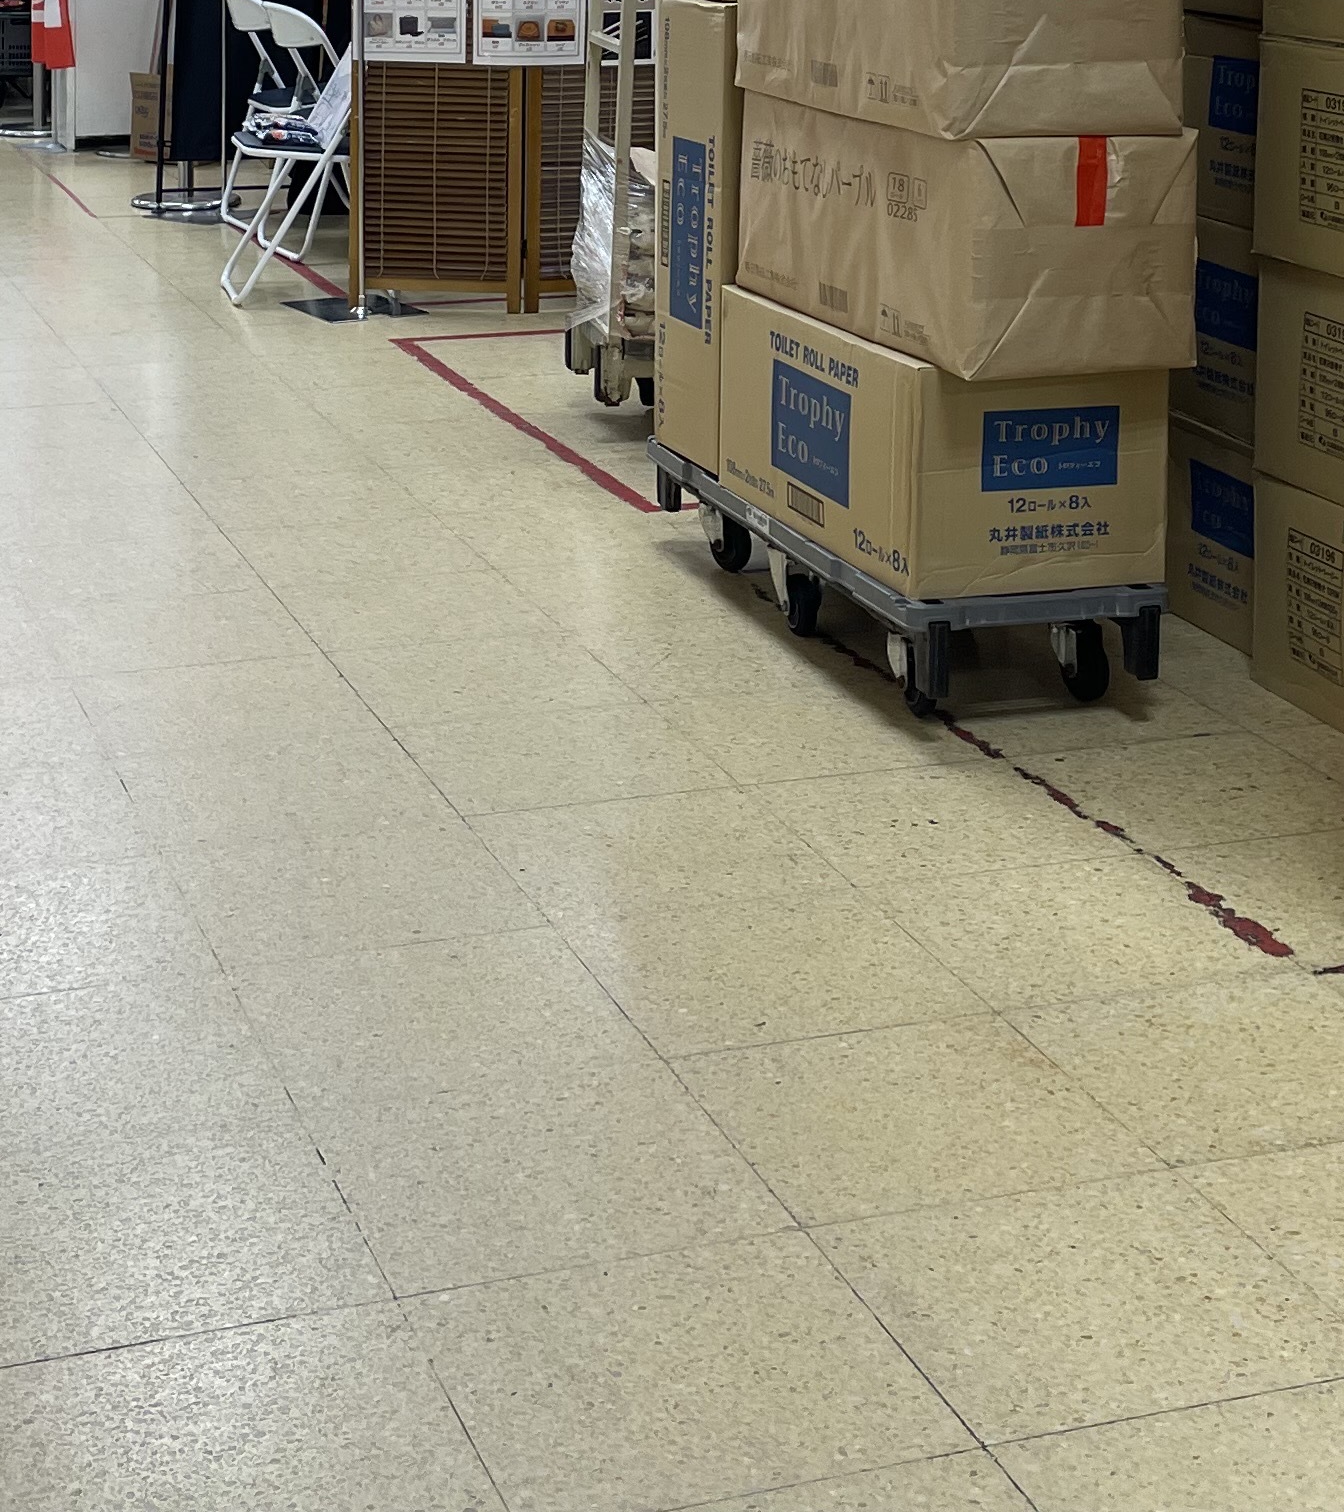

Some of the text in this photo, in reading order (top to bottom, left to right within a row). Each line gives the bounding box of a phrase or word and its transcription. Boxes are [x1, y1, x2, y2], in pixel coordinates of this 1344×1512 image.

[1213, 96, 1244, 117] Eco
[889, 176, 906, 193] 18
[704, 134, 715, 346] TOILET ROLL PAPER
[769, 329, 860, 389] TOILET ROLL PAPER
[777, 374, 846, 443] Trophy
[993, 415, 1110, 445] Trophy
[776, 425, 810, 465] Eco
[992, 454, 1049, 479] Eco
[1007, 494, 1092, 515] 12ロール×8入
[988, 521, 1110, 544] 丸井製紙株式会社
[852, 527, 910, 577] 12ロール×8入
[1308, 540, 1337, 564] 03196
